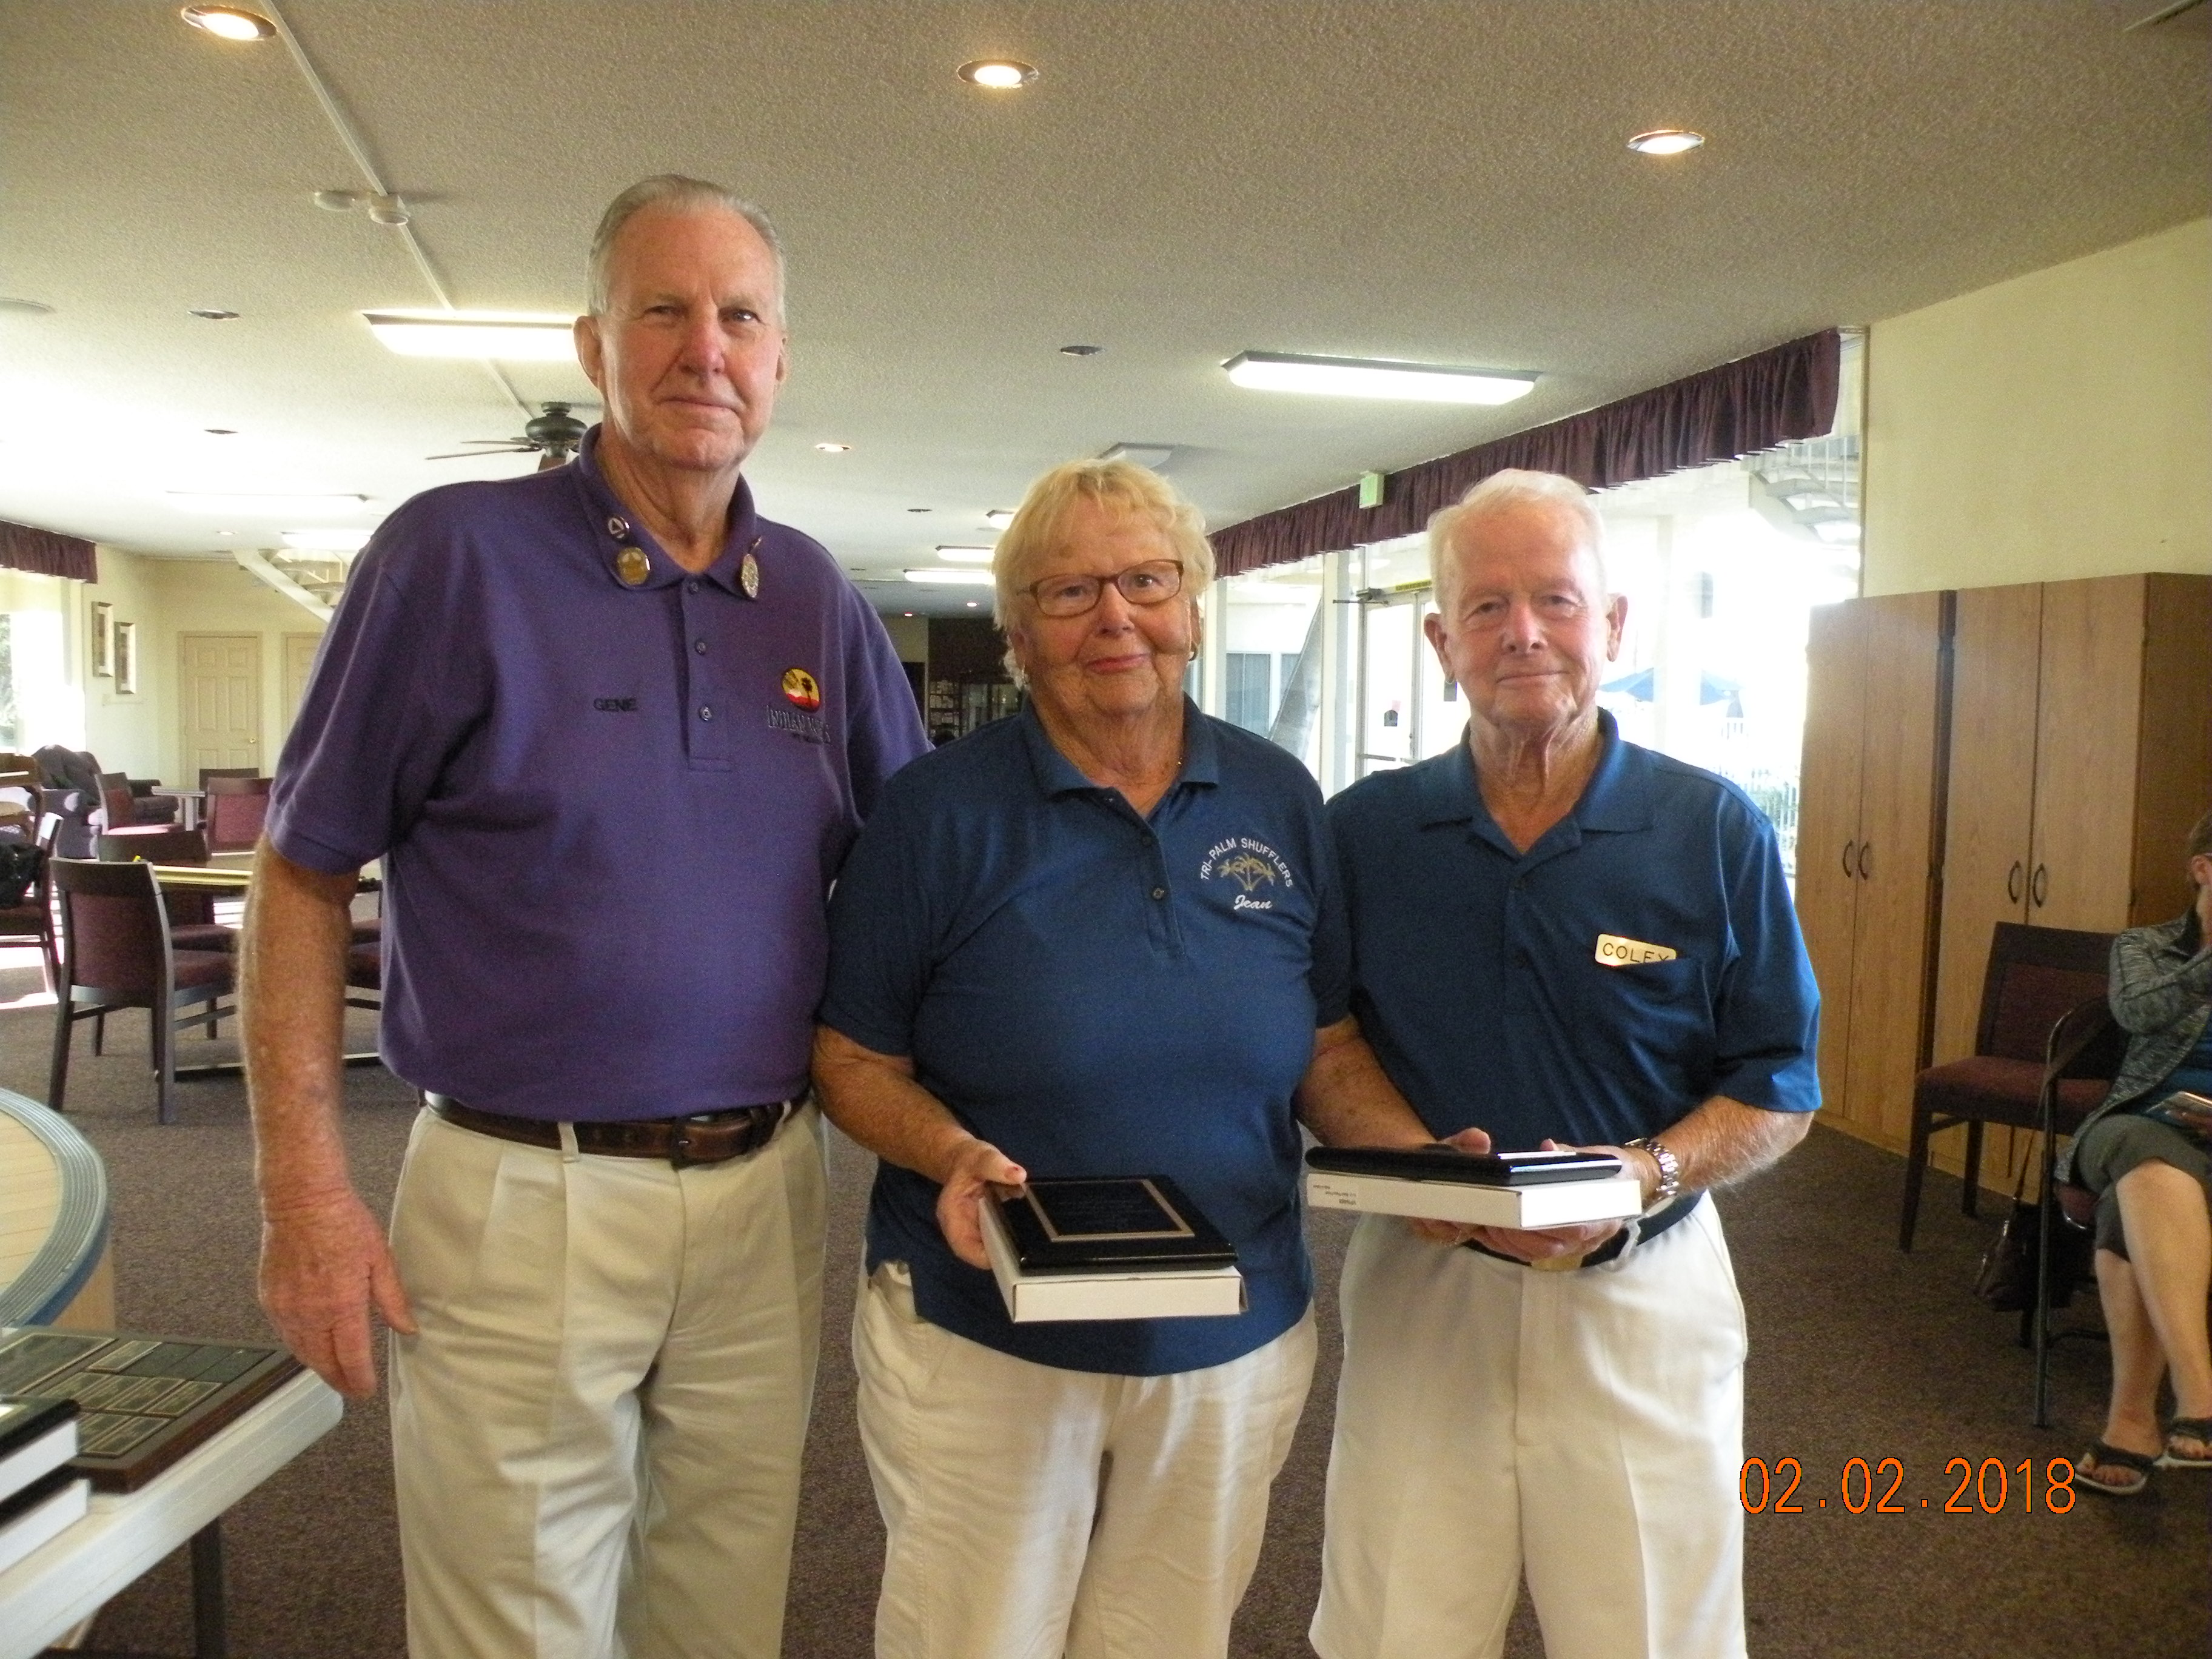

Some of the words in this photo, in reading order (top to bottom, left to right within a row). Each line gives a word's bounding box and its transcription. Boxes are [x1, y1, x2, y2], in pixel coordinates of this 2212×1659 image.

[594, 698, 638, 712] GENE
[1201, 837, 1236, 880] TRI-PALM
[1241, 837, 1293, 888] SHUFFLERS
[1233, 894, 1273, 910] Jean
